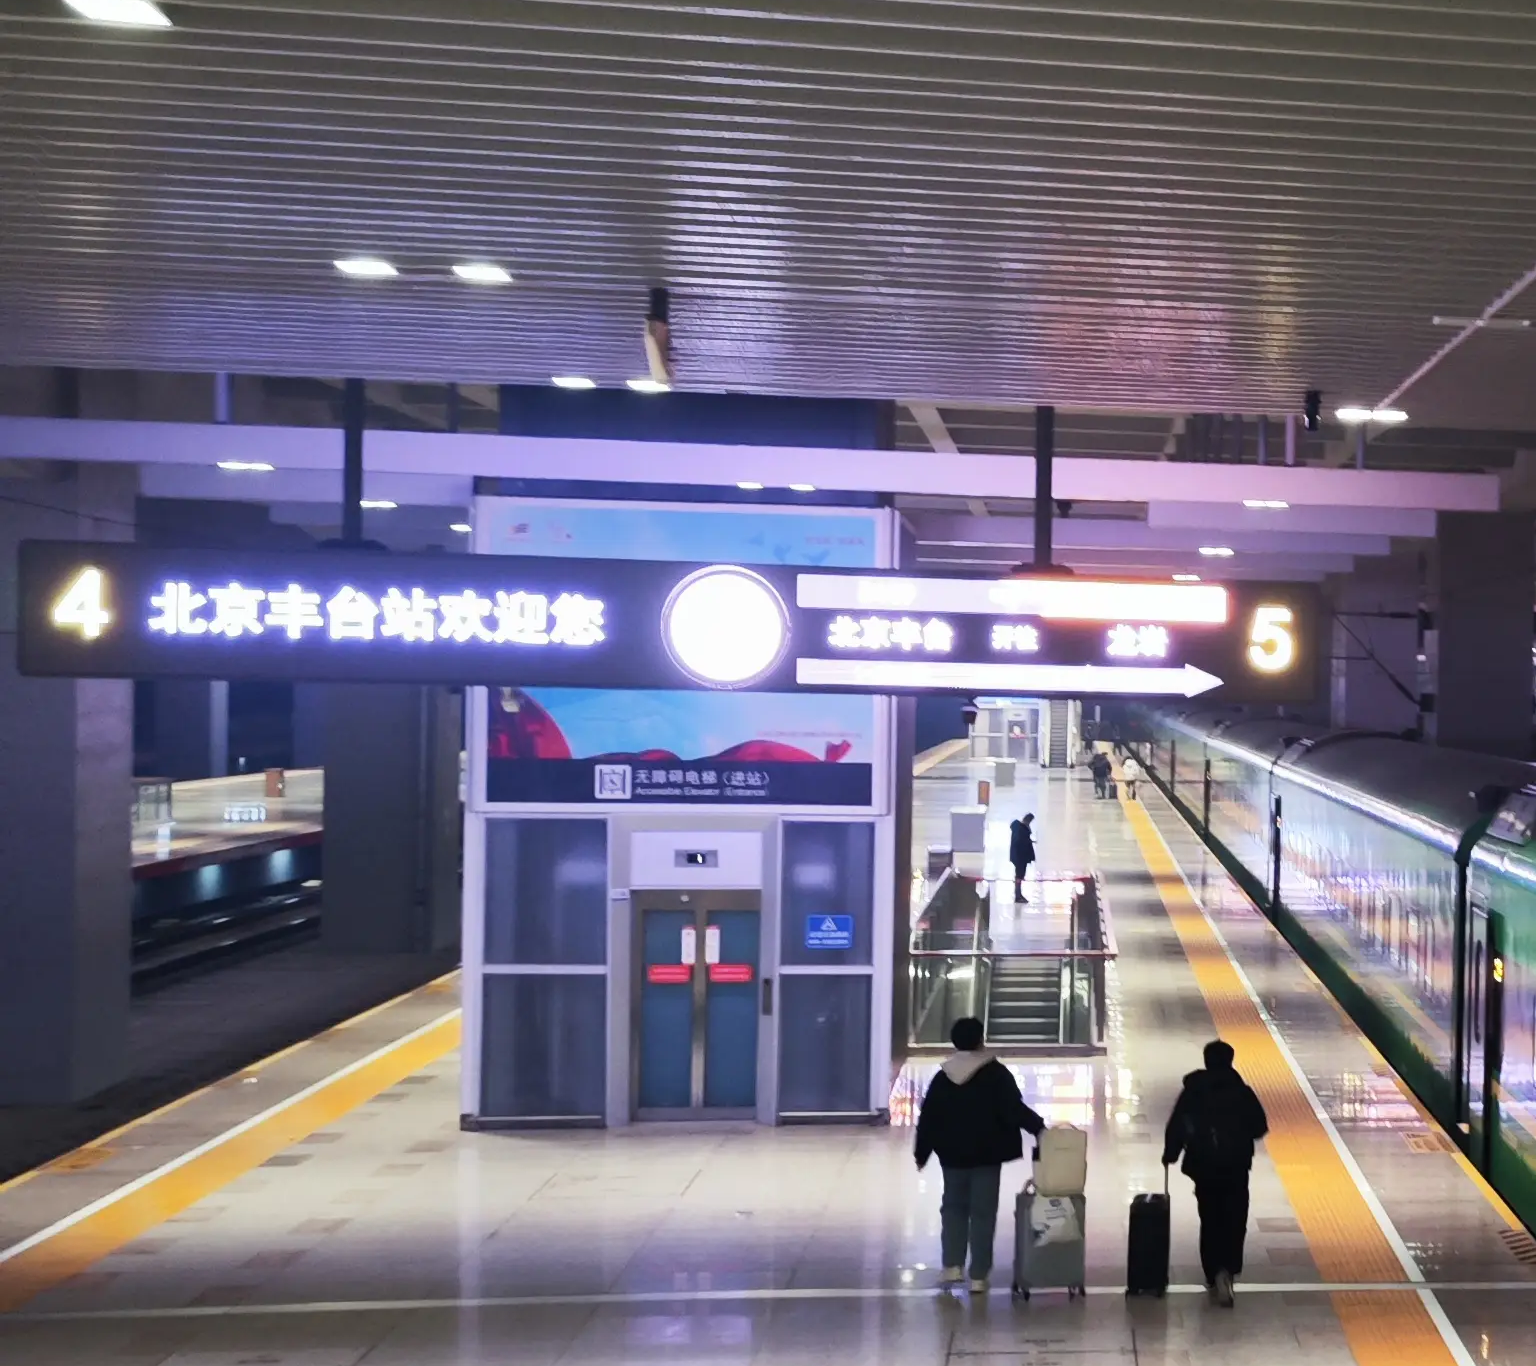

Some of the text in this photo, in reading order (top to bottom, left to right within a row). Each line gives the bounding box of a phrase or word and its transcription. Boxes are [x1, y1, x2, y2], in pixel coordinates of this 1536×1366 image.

[53, 566, 110, 638] 4
[148, 581, 606, 645] 北京丰台站欢迎您
[1248, 605, 1292, 672] 5
